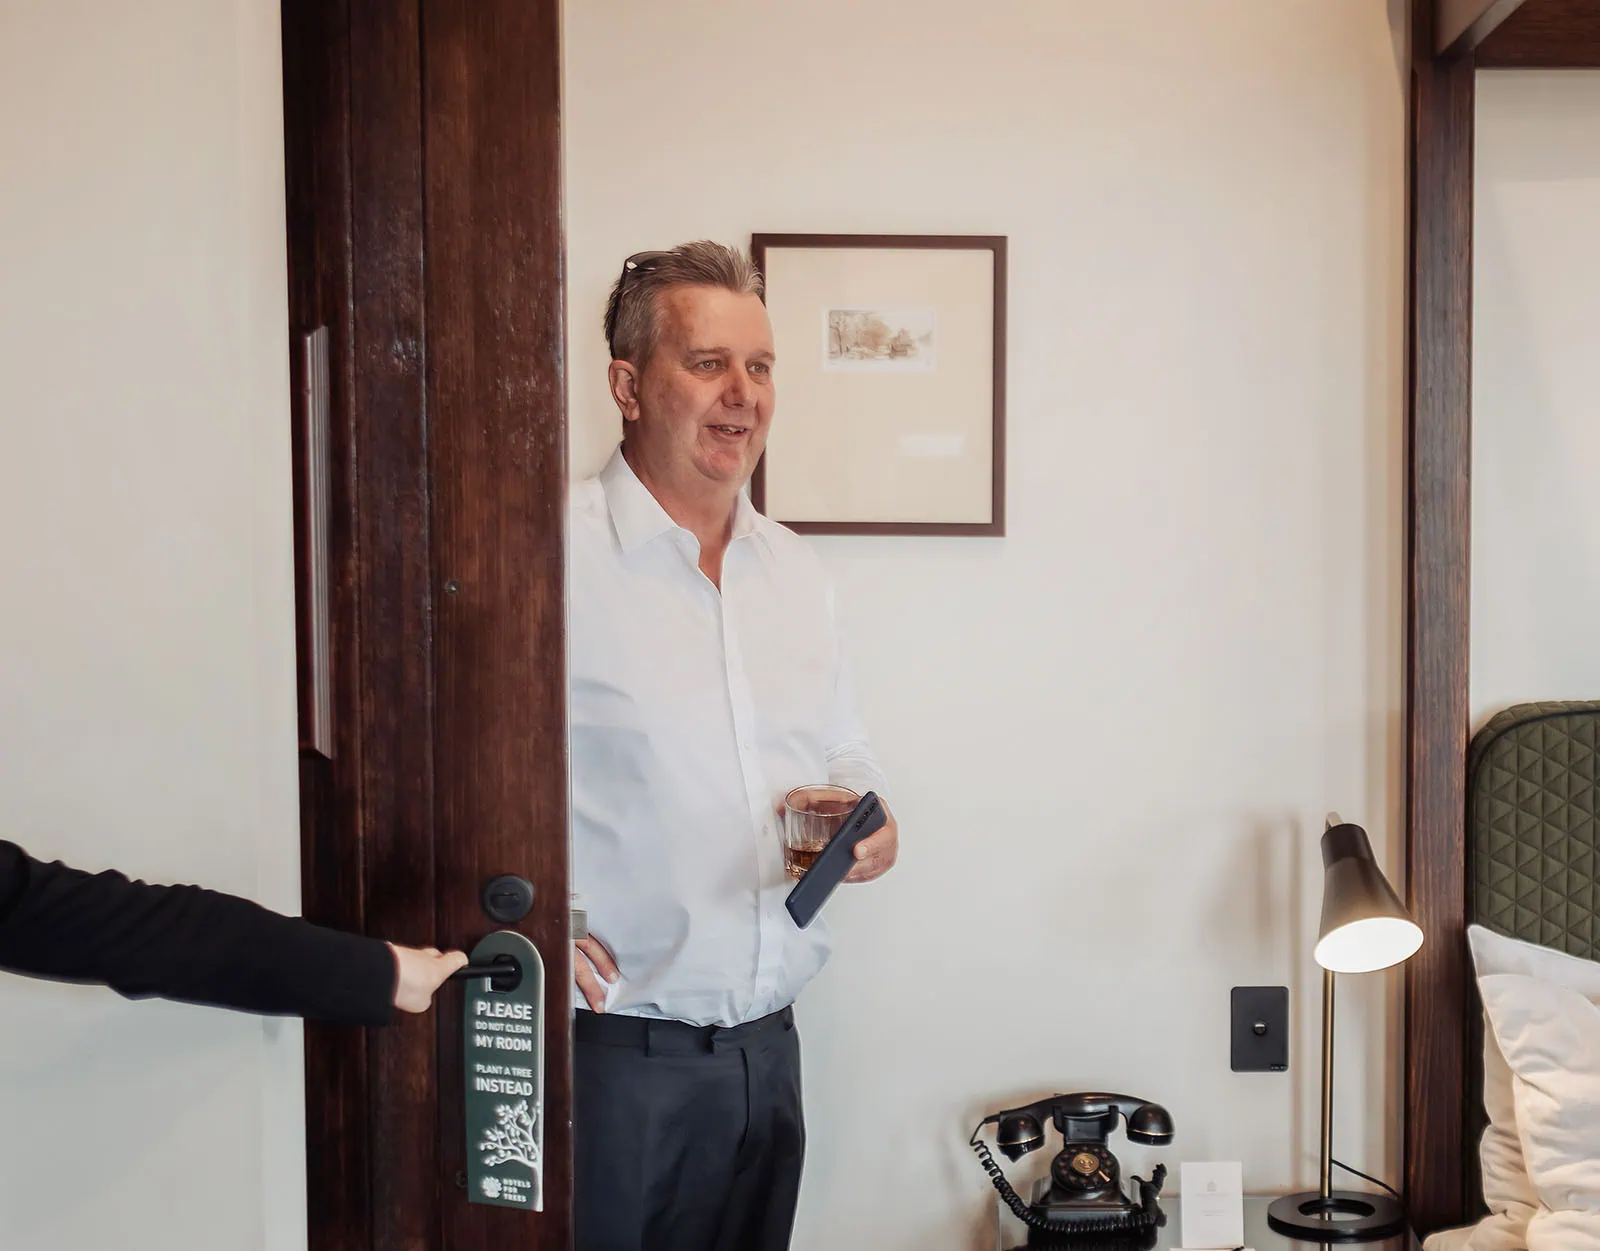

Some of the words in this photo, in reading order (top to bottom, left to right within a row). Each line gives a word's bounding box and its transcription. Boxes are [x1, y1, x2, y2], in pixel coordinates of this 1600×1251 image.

[476, 1000, 533, 1020] PLEASE
[475, 1021, 487, 1030] DO
[488, 1022, 505, 1032] NOT
[505, 1023, 532, 1034] CLEAN
[475, 1034, 494, 1048] MY
[496, 1036, 532, 1052] ROOM
[475, 1063, 503, 1075] PLANT
[504, 1066, 511, 1076] A
[511, 1067, 533, 1078] TREE
[475, 1077, 533, 1096] INSTEAD
[503, 1178, 532, 1189] HOTELS
[503, 1193, 527, 1203] TREES
